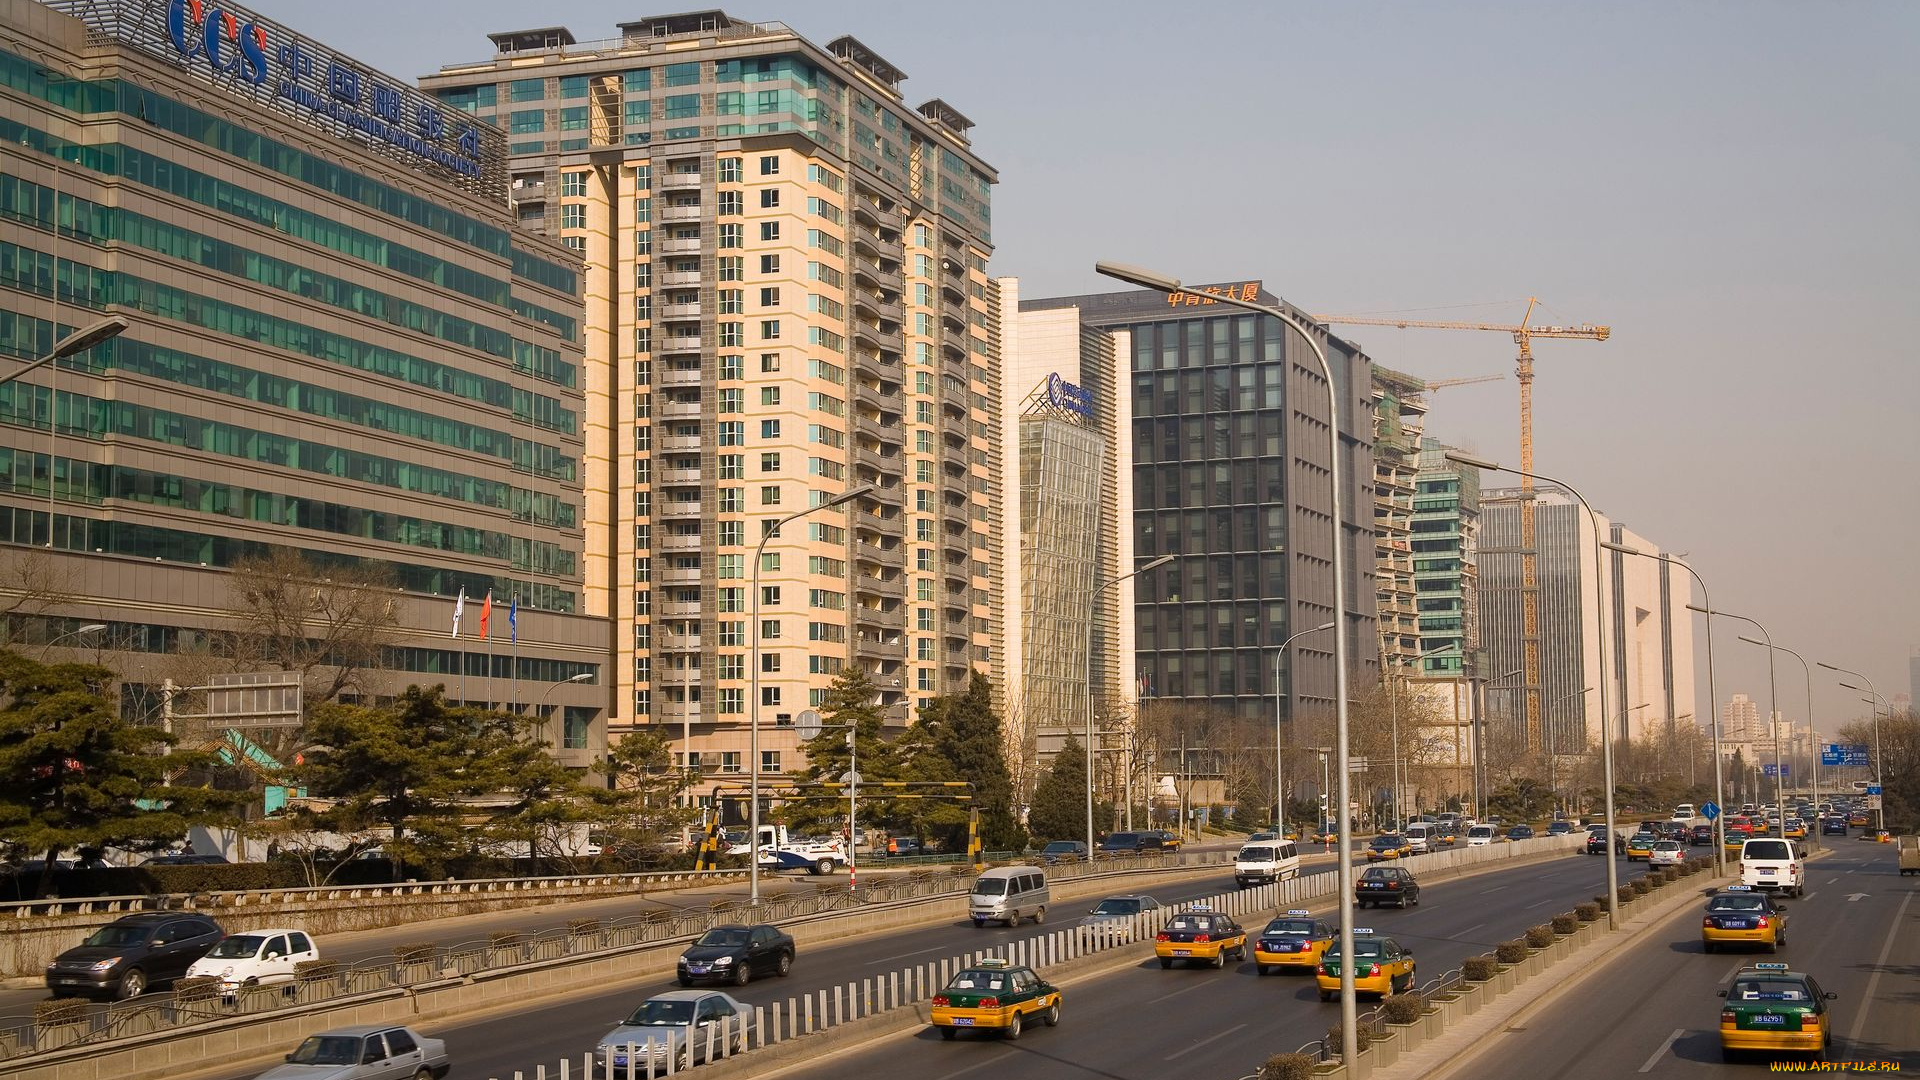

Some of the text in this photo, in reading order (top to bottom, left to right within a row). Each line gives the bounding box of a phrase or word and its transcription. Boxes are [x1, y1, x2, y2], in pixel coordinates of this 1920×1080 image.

[167, 0, 267, 84] CCS
[279, 44, 481, 158] 中国船级社
[279, 81, 482, 179] CHINA CLASSIFICATION SOCIETY
